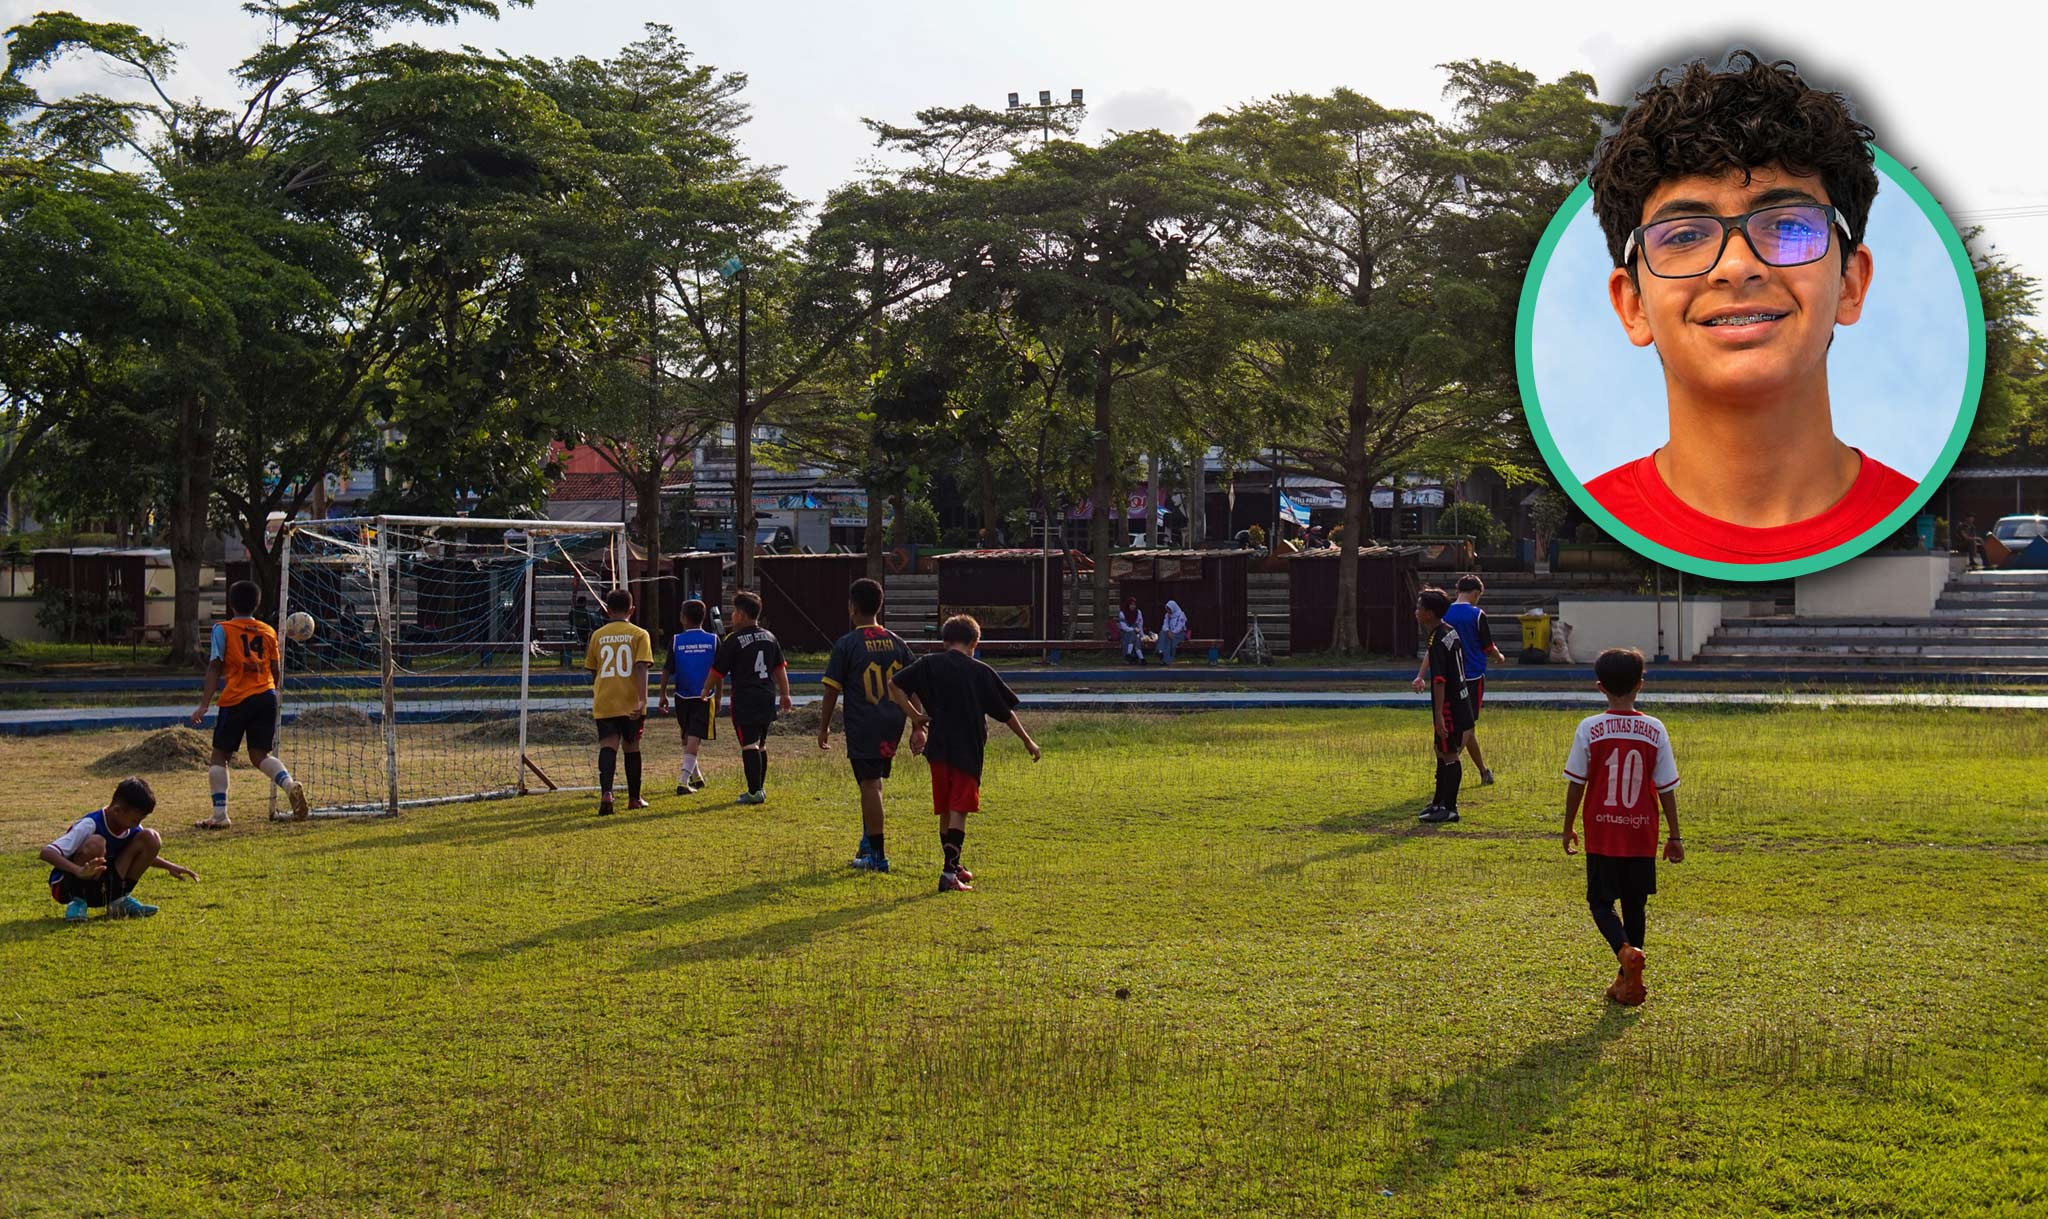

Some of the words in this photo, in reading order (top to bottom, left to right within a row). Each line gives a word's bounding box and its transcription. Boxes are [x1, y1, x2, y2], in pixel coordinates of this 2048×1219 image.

[600, 644, 633, 679] 20
[754, 650, 769, 679] 4
[1590, 722, 1604, 740] SSB
[1606, 718, 1632, 734] TUNAS
[1633, 719, 1660, 744] BHAKTI
[1603, 747, 1644, 809] 10
[1596, 813, 1650, 829] ortuseight
